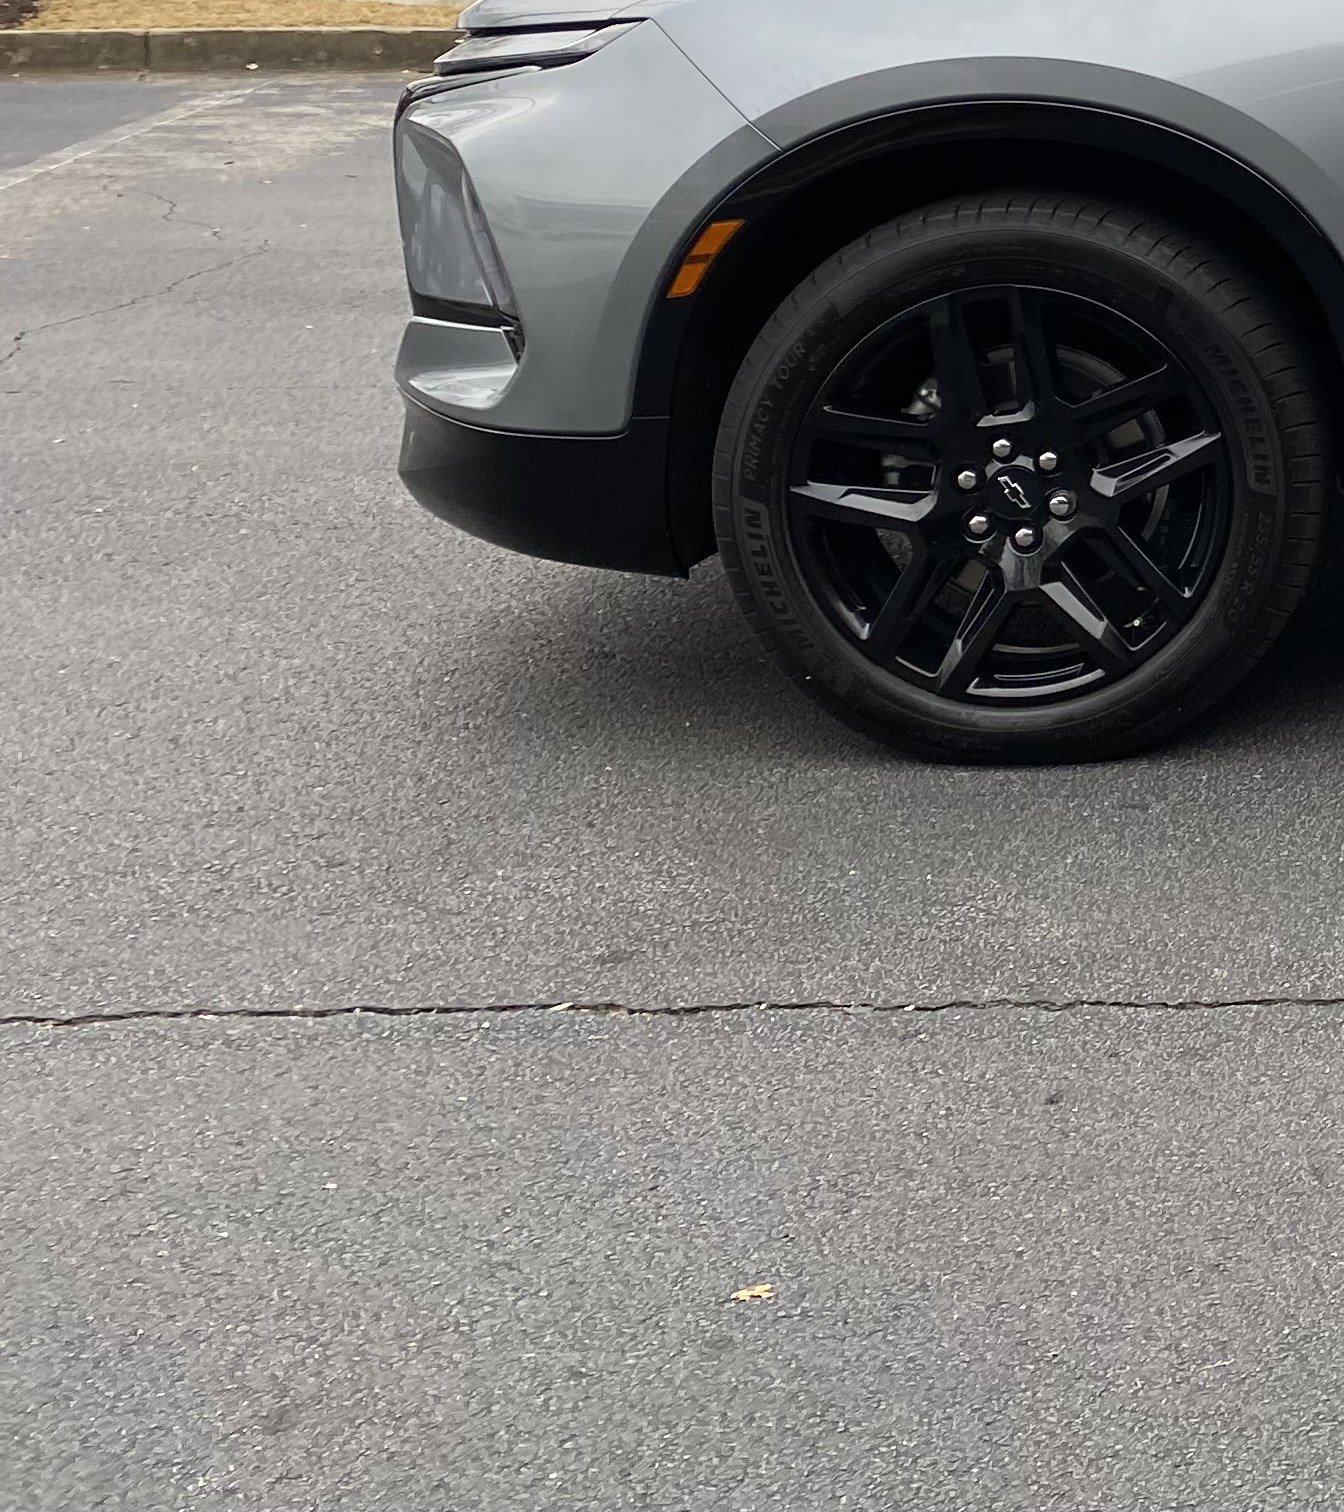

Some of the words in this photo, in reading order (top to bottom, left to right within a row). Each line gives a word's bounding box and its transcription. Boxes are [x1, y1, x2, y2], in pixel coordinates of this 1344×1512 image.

[740, 395, 773, 481] PRIMACY
[771, 342, 807, 389] TOUR
[744, 508, 814, 649] MICHELIN
